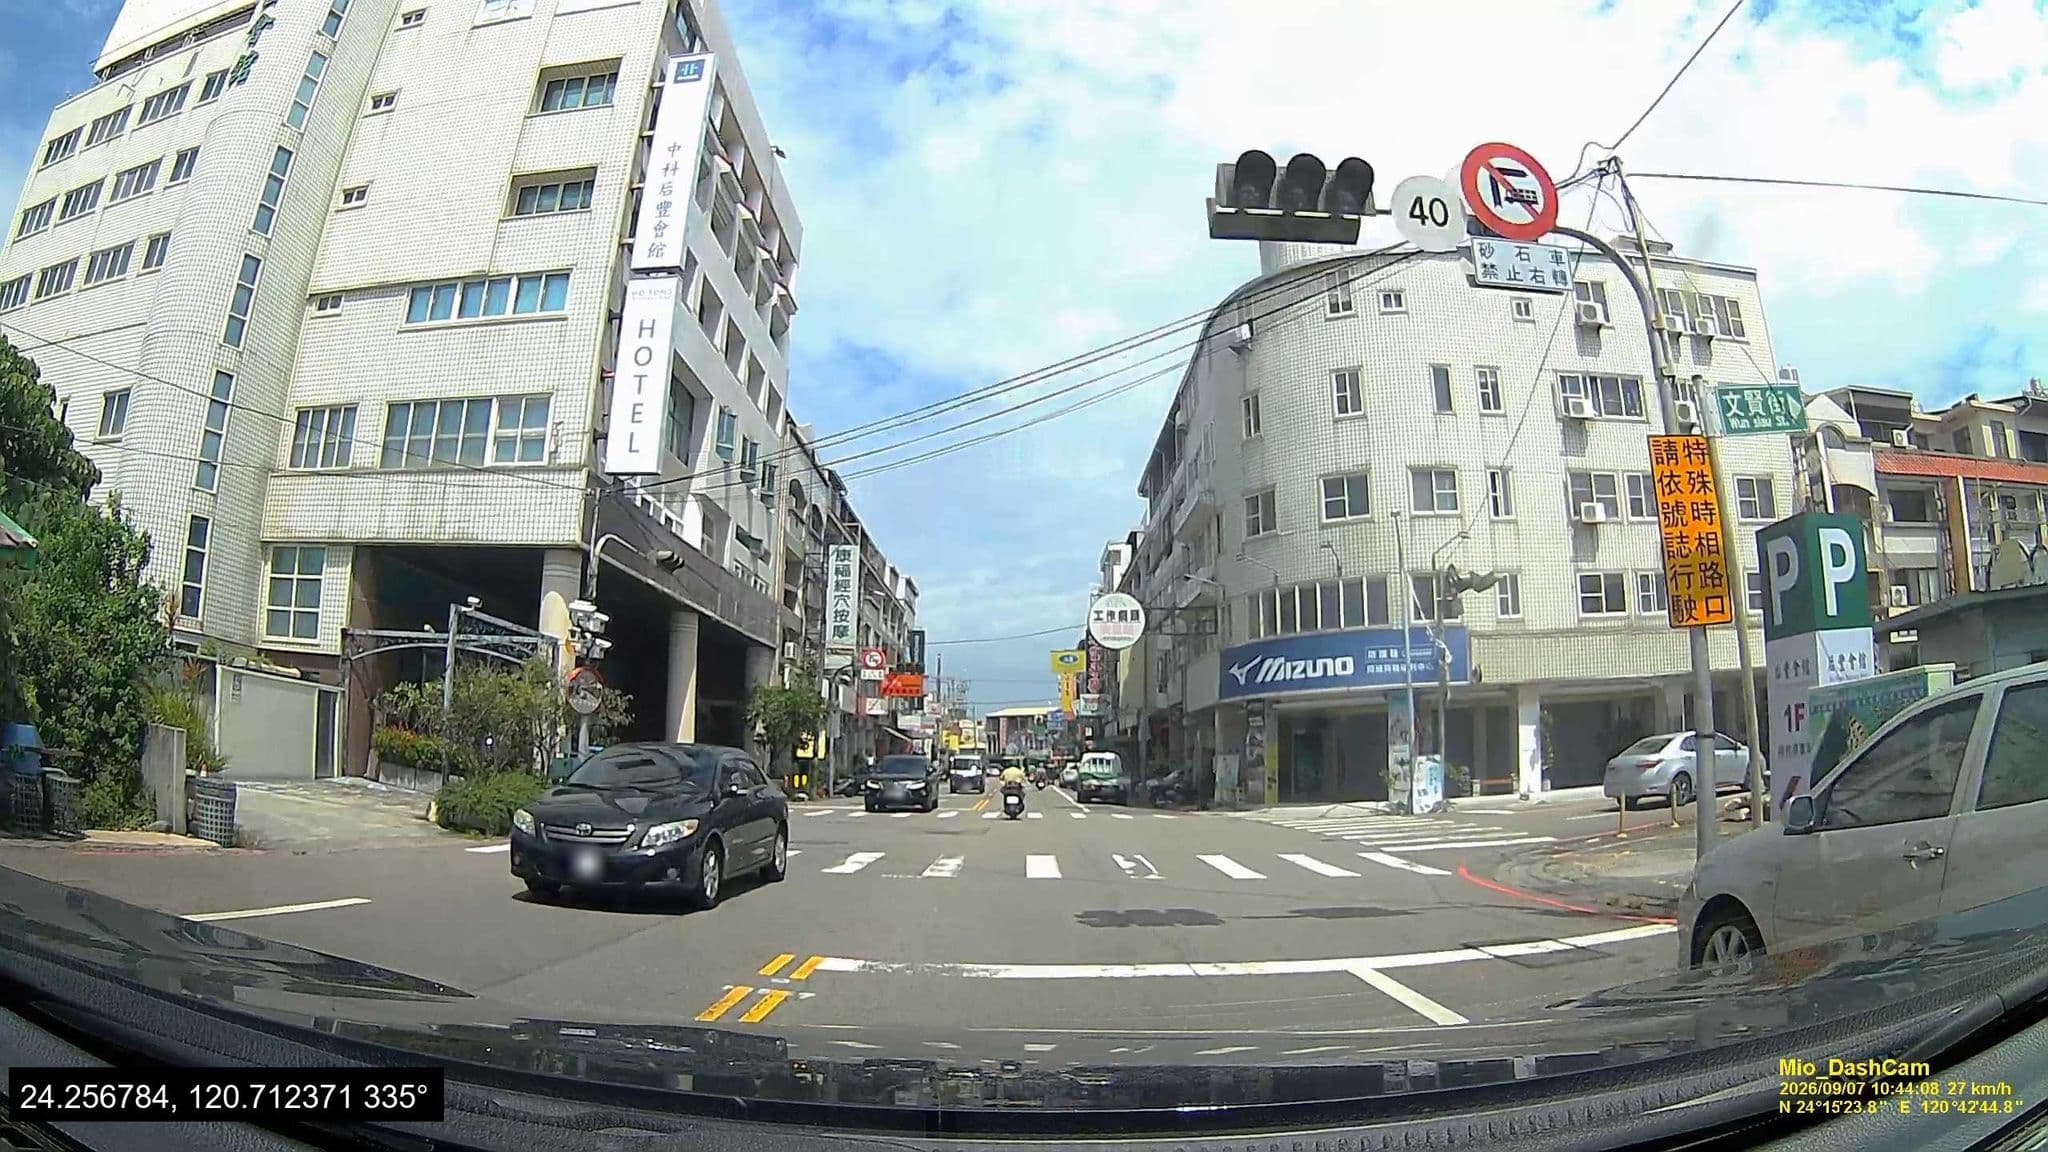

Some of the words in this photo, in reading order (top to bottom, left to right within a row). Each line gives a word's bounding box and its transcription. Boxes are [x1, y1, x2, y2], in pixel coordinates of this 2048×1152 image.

[647, 142, 682, 259] 中科后豐會館
[1409, 195, 1449, 227] 40
[1479, 242, 1566, 265] 砂石車
[1481, 264, 1568, 286] 禁止右轉
[628, 318, 656, 453] HOTEL
[1721, 390, 1786, 417] 文賢街
[1651, 439, 1699, 624] 請依號誌行駛
[1682, 441, 1726, 617] 特殊時相路口
[1819, 527, 1856, 617] P
[1766, 535, 1799, 626] P
[1784, 702, 1805, 733] 1F
